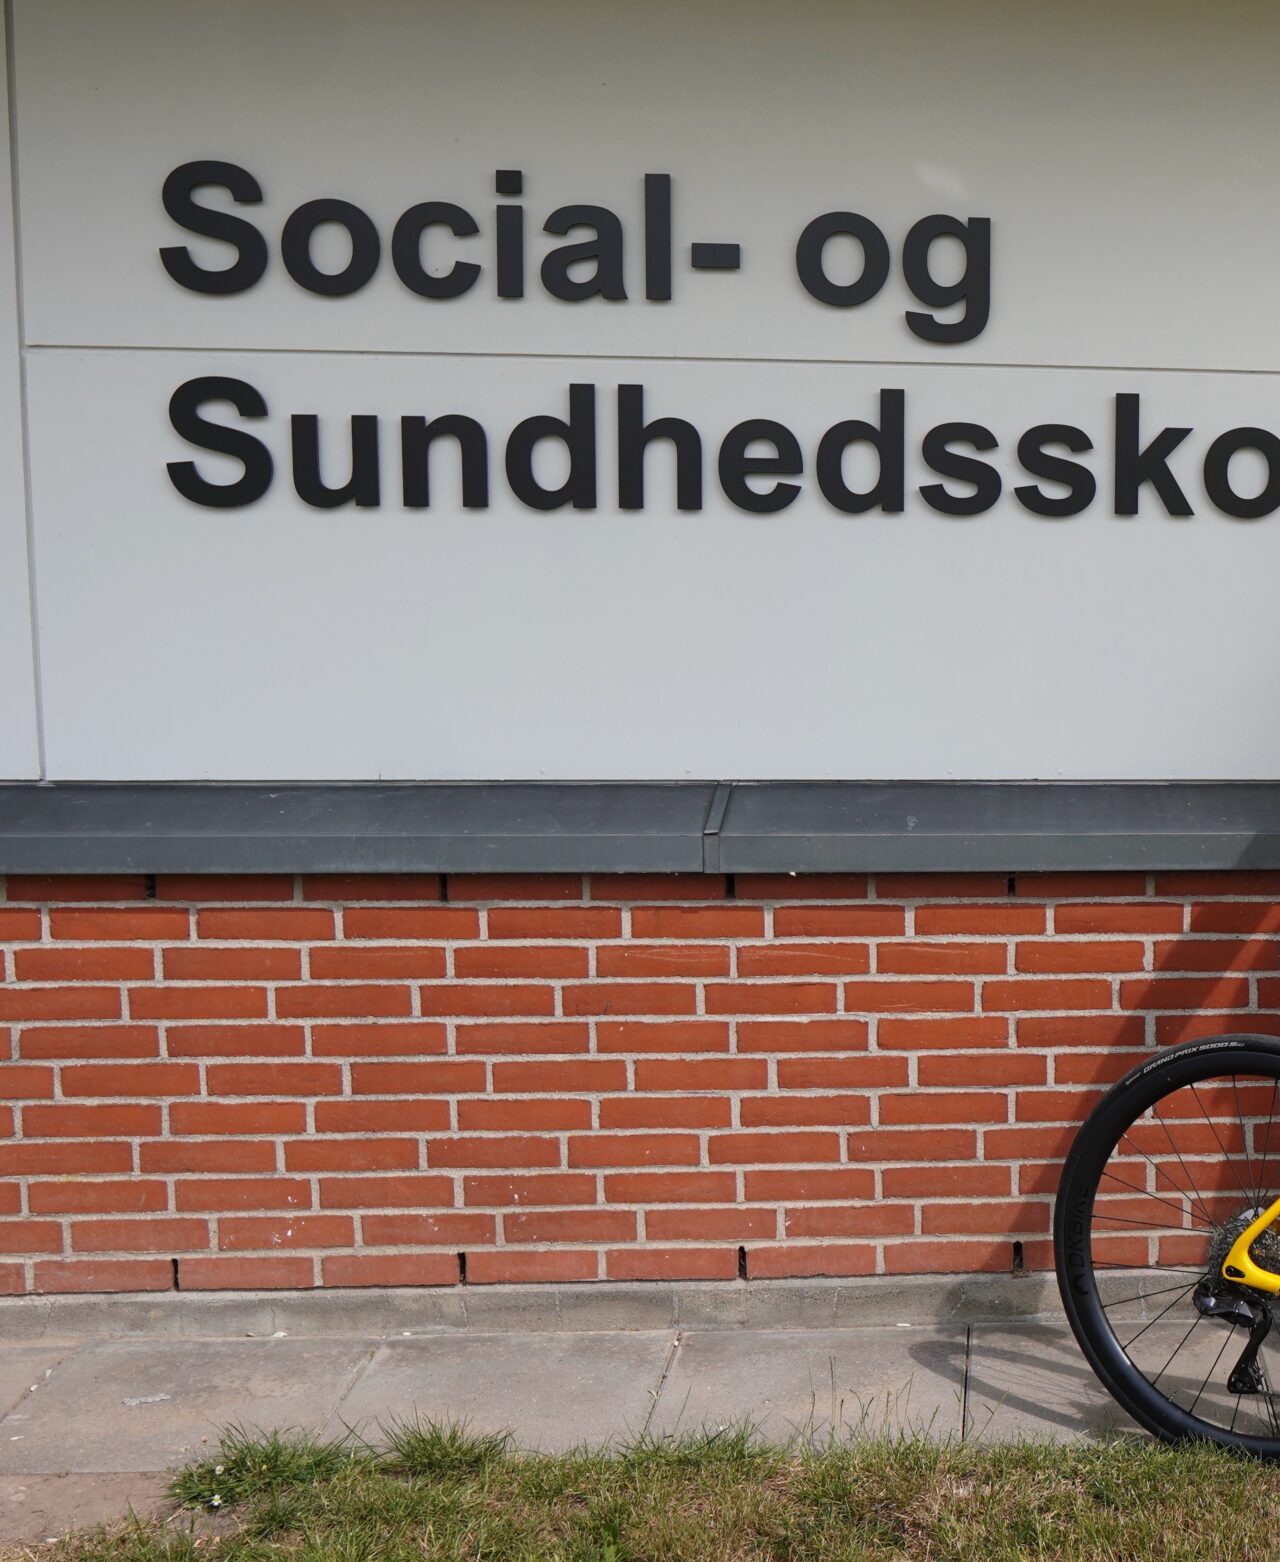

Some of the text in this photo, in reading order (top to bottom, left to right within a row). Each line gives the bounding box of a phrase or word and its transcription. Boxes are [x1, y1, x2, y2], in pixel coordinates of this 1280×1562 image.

[159, 159, 991, 343] Social- og
[1143, 1053, 1174, 1074] GRAND
[1174, 1046, 1199, 1058] PRIX
[1198, 1042, 1228, 1052] 5000
